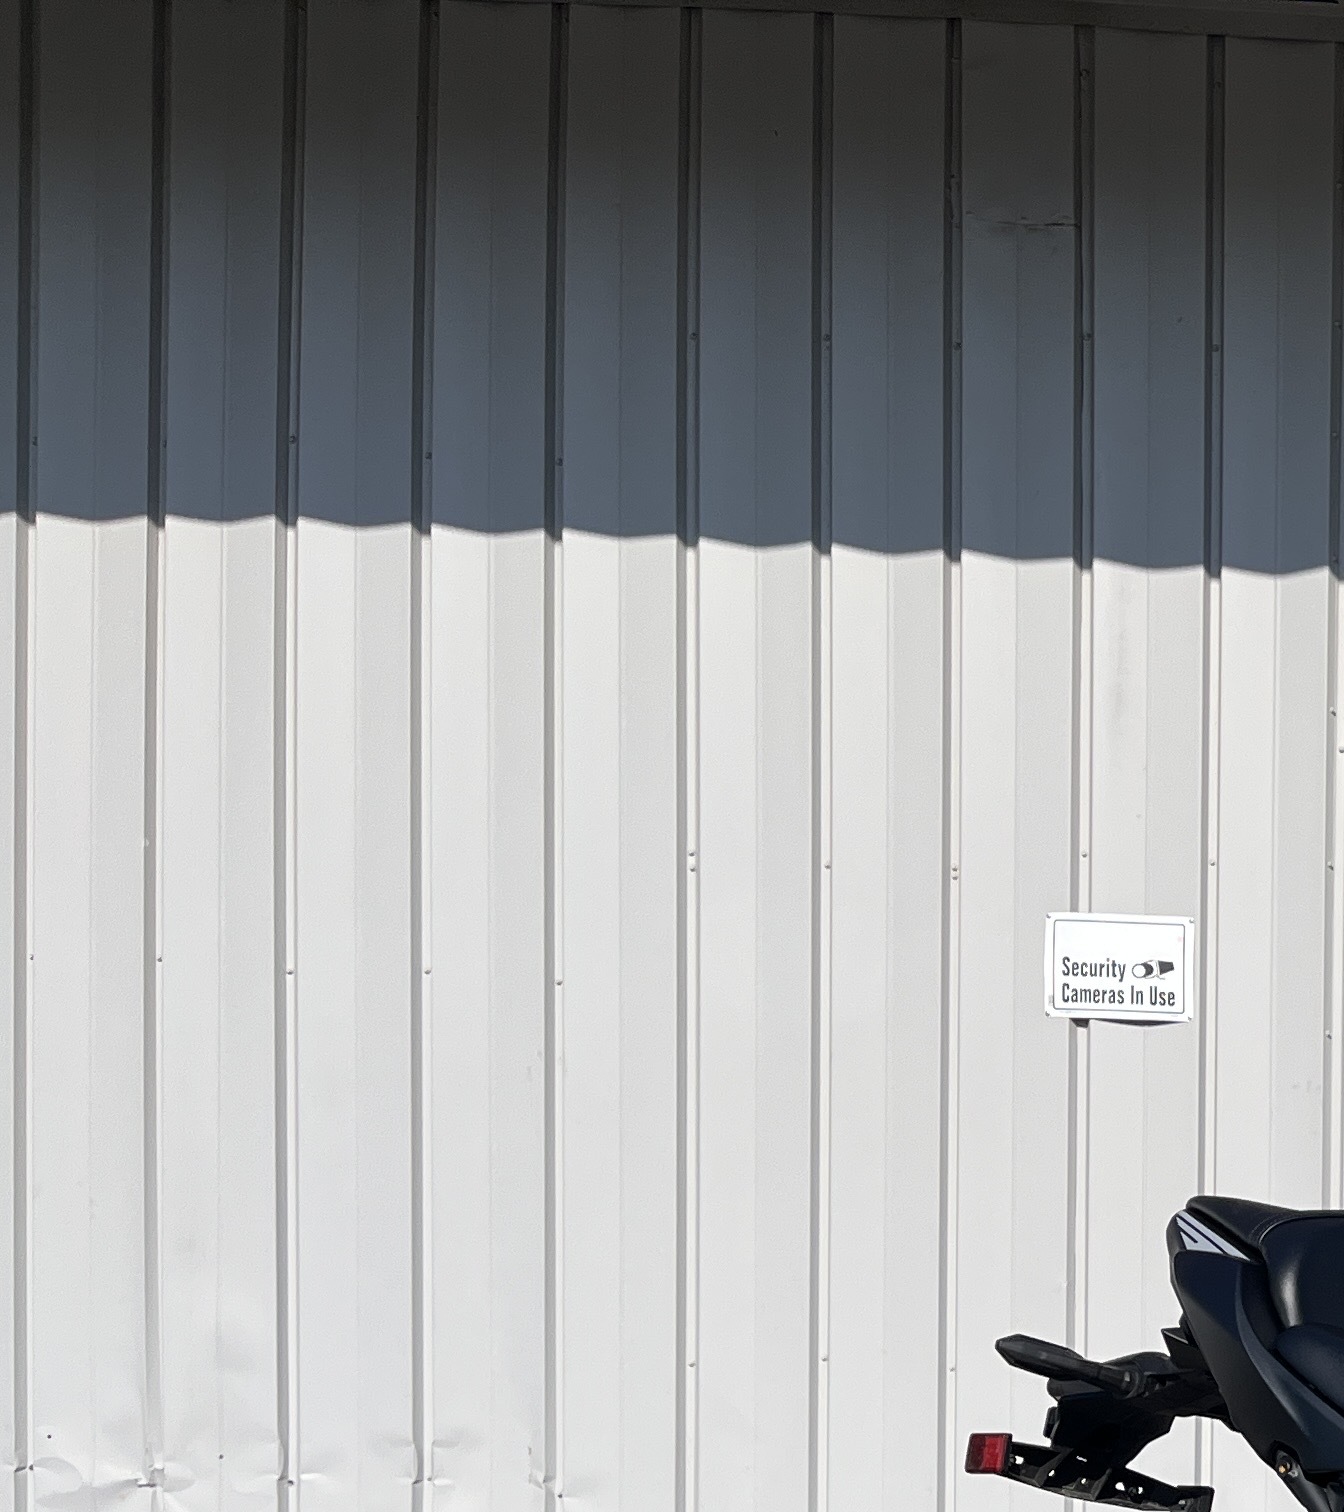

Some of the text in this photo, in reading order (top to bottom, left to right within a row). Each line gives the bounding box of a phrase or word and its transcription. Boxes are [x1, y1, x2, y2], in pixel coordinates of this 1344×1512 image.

[1062, 956, 1126, 982] Security
[1062, 983, 1176, 1007] Cameras In Use
